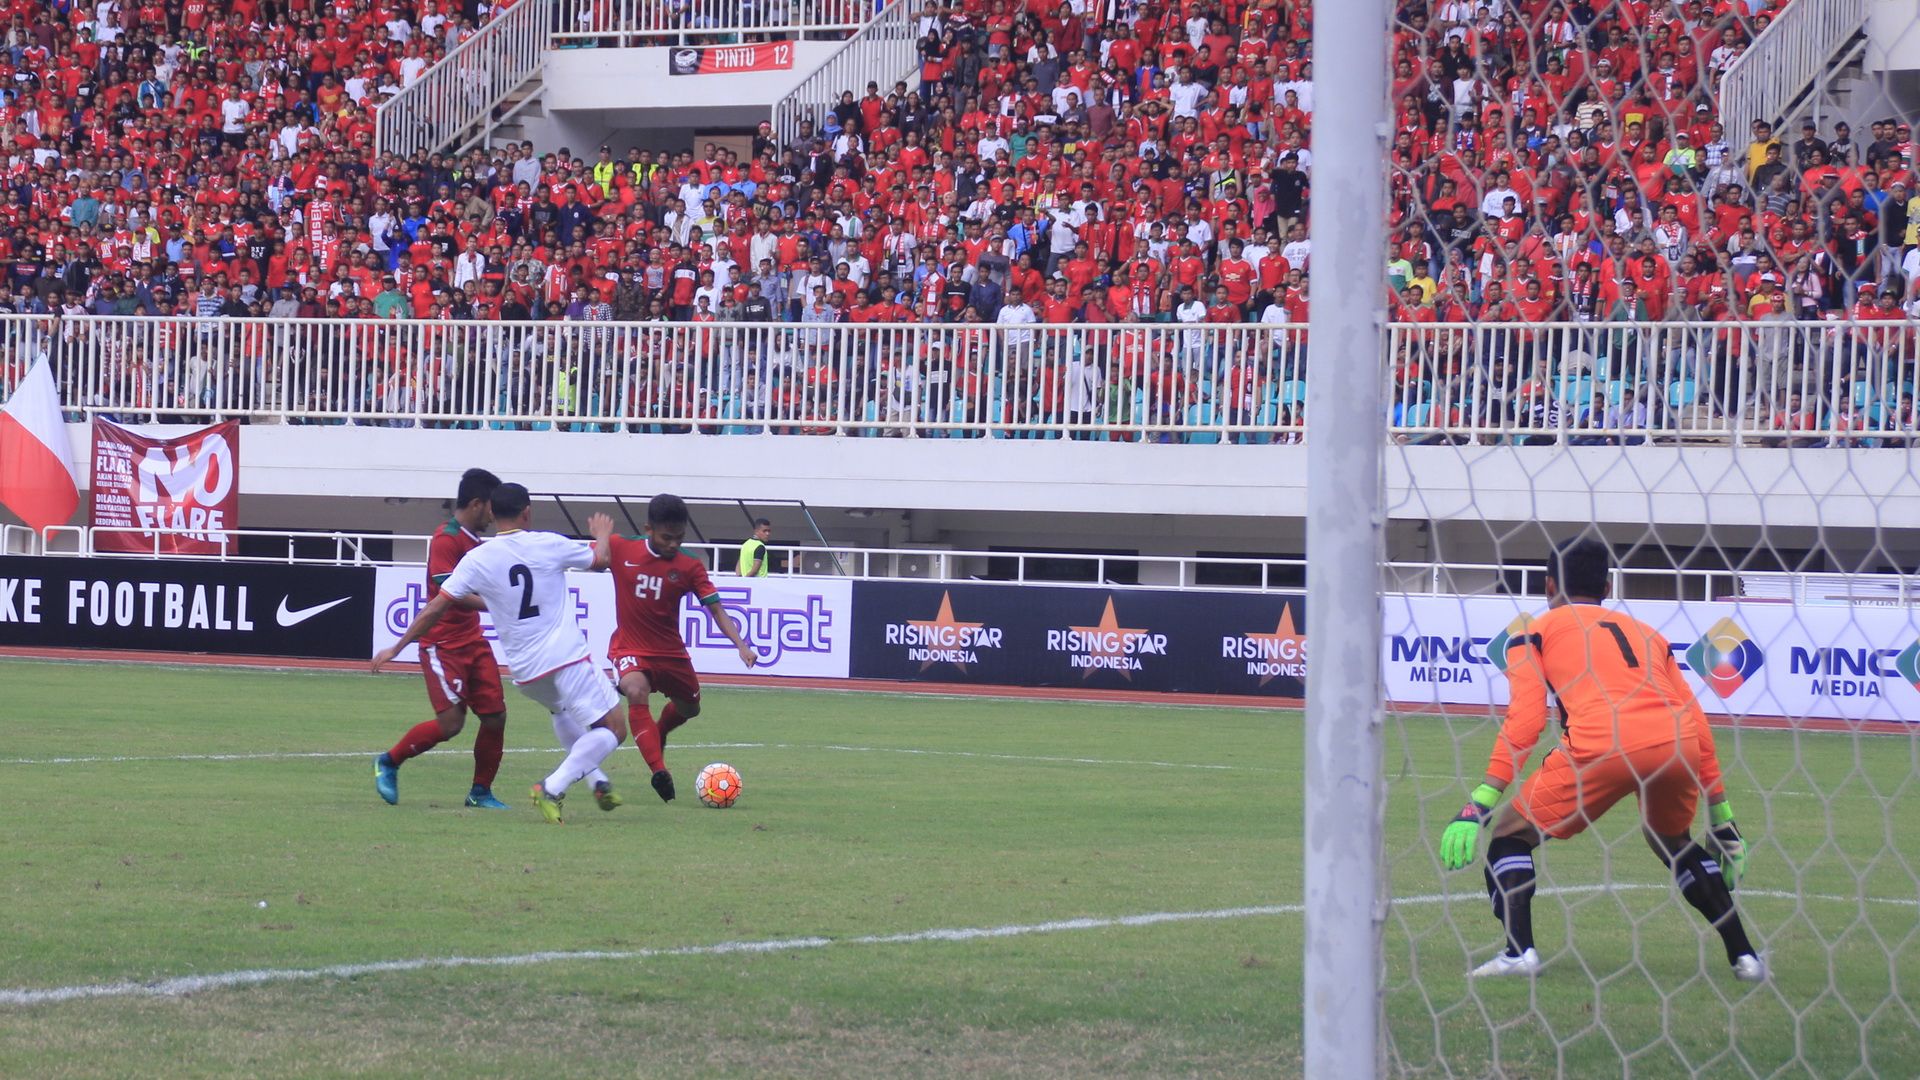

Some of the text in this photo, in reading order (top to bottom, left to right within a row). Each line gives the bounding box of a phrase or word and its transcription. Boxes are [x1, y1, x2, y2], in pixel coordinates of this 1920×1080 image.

[715, 45, 789, 68] PINTU 12
[97, 456, 132, 474] FLARE
[138, 433, 233, 507] NO
[135, 505, 229, 543] FLARE
[509, 563, 540, 620] 2
[635, 574, 663, 600] 24
[0, 578, 253, 631] KE FOOTBALL
[885, 624, 1002, 649] RISING STAR
[1047, 629, 1167, 655] RISING STAR
[1222, 636, 1297, 660] RISING
[1597, 621, 1639, 668] 1
[908, 648, 978, 664] INDONESIA
[1071, 654, 1143, 671] INDONESIA
[1391, 635, 1494, 665] MNC
[1790, 646, 1902, 678] MNC
[619, 655, 637, 671] 24
[1247, 661, 1307, 677] INDONES
[1410, 666, 1473, 684] MEDIA
[1811, 679, 1881, 697] MEDIA
